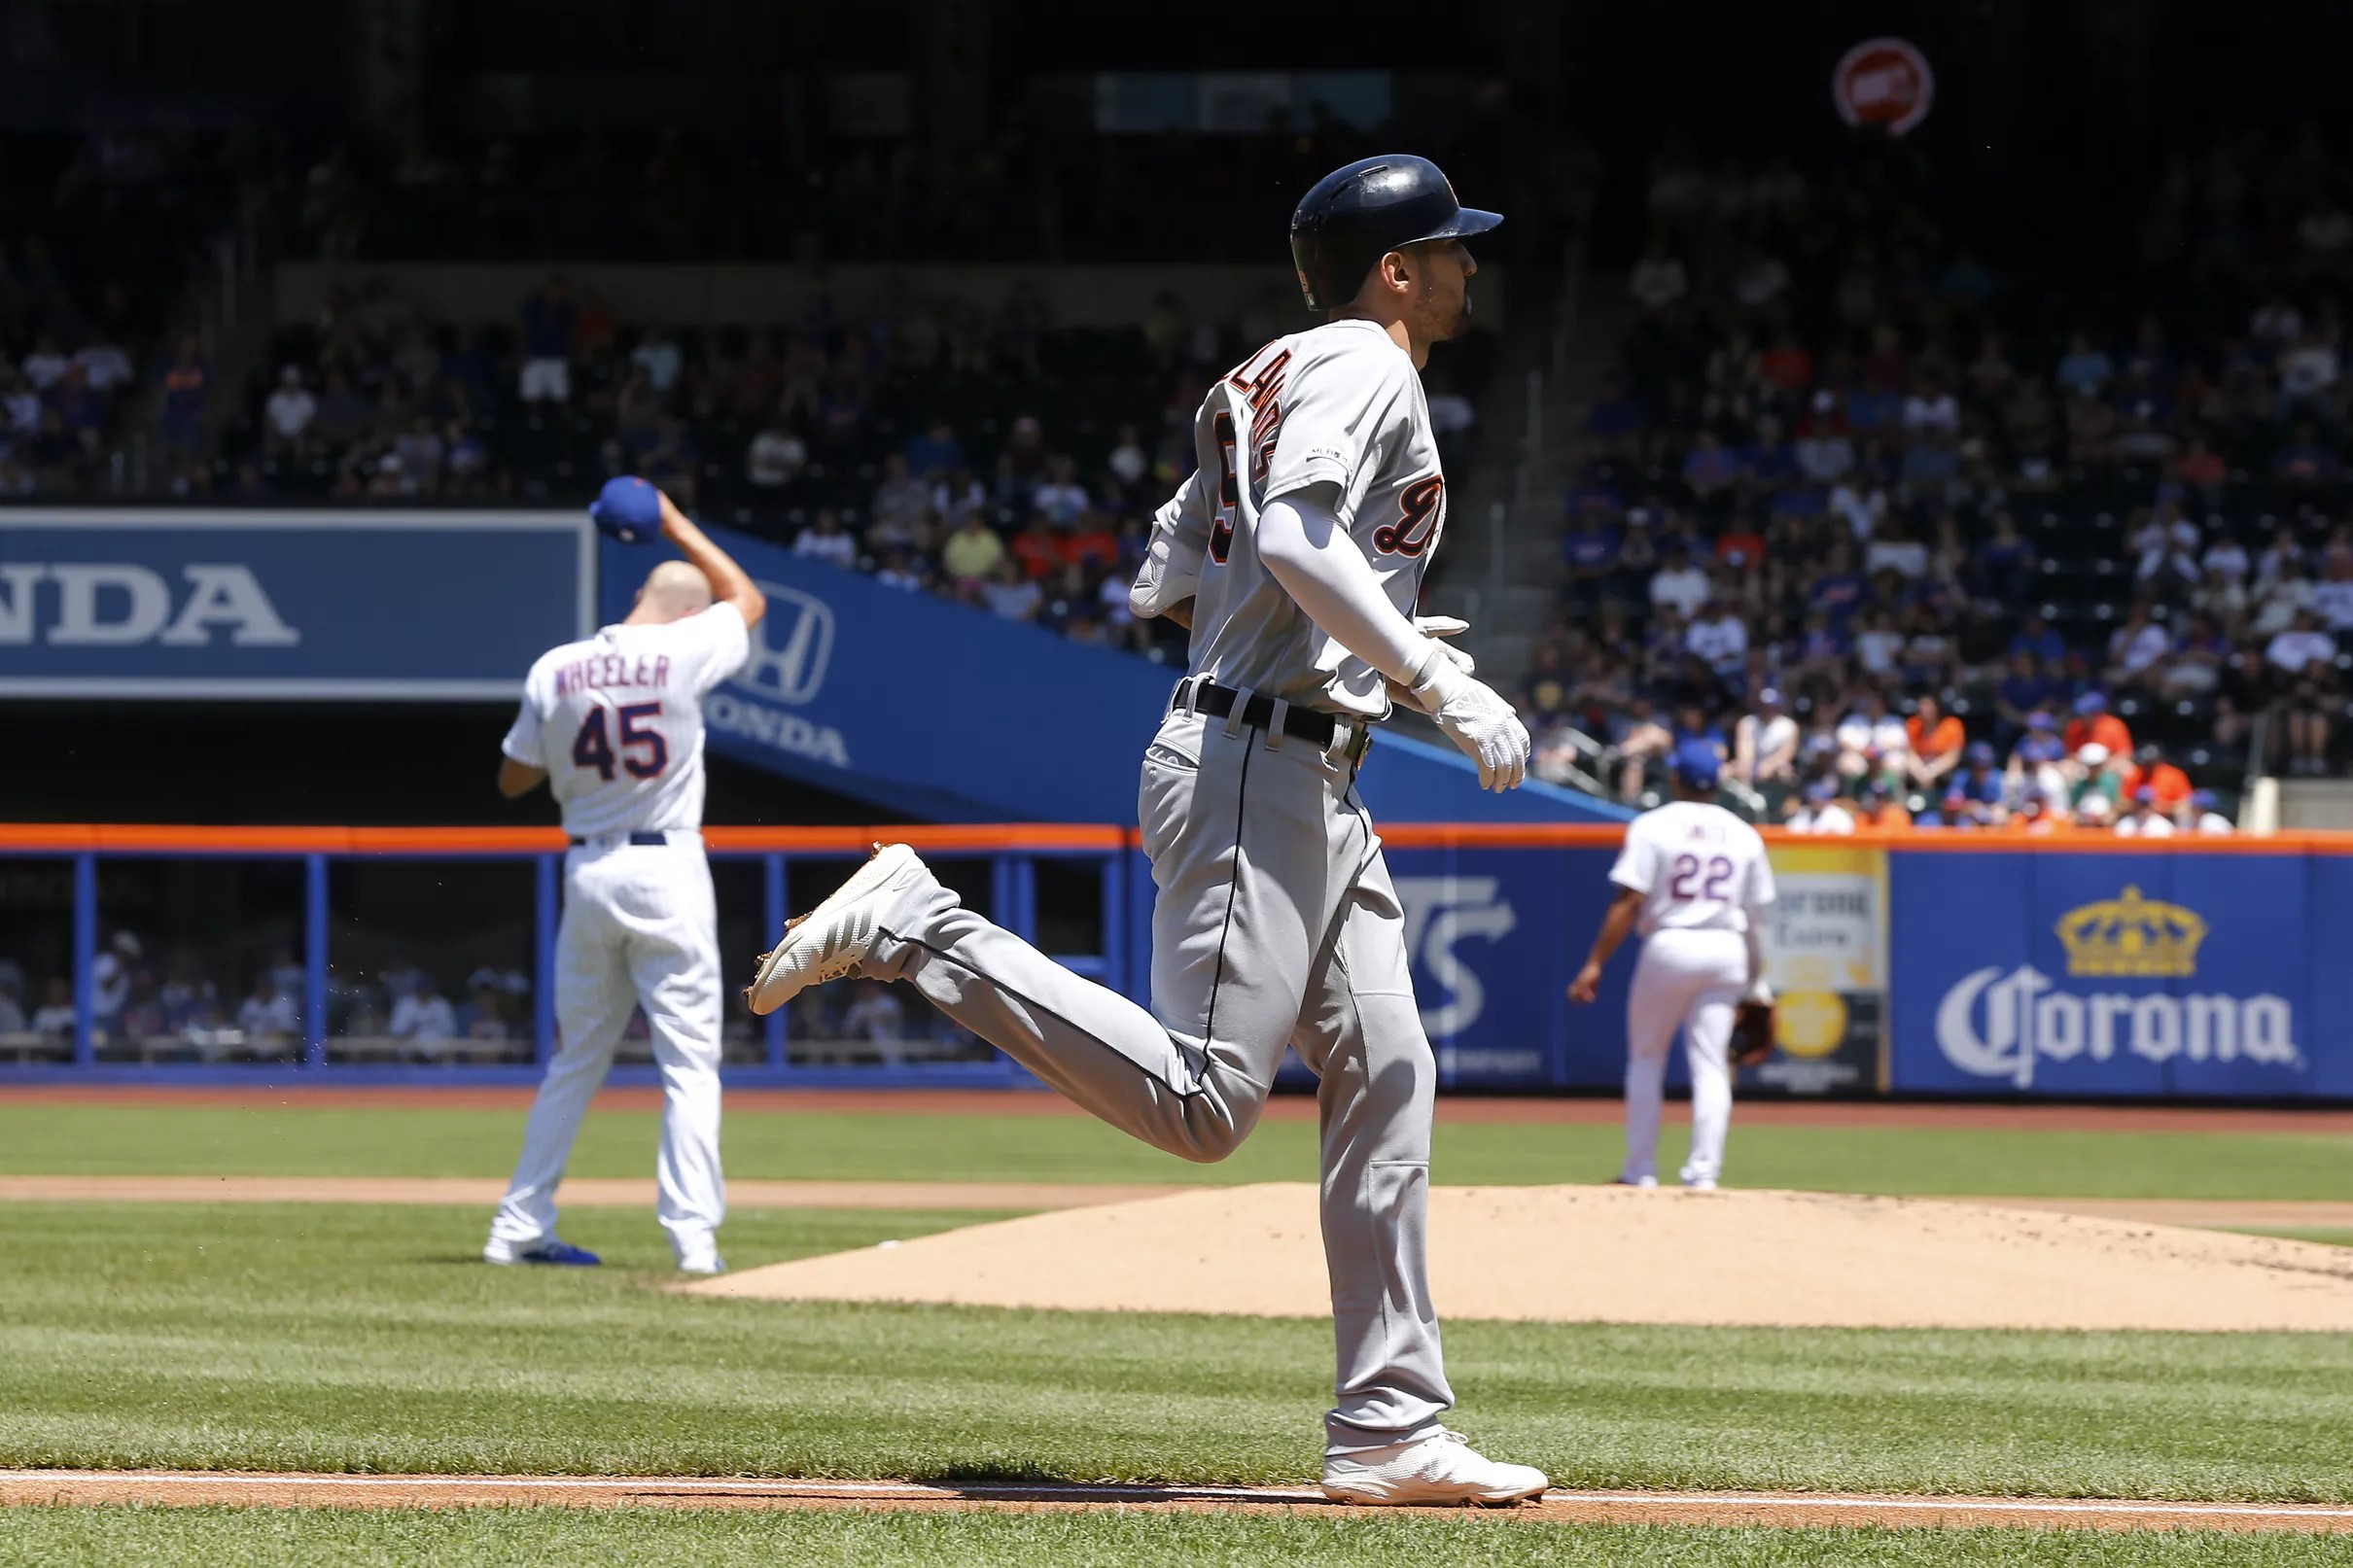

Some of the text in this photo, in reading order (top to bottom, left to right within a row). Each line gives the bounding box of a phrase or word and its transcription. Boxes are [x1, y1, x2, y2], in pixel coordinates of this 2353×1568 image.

[555, 653, 670, 697] WHEELER
[572, 700, 669, 782] 45
[702, 692, 853, 768] ONDA
[1669, 852, 1734, 902] 22
[1934, 962, 2299, 1089] Corona
